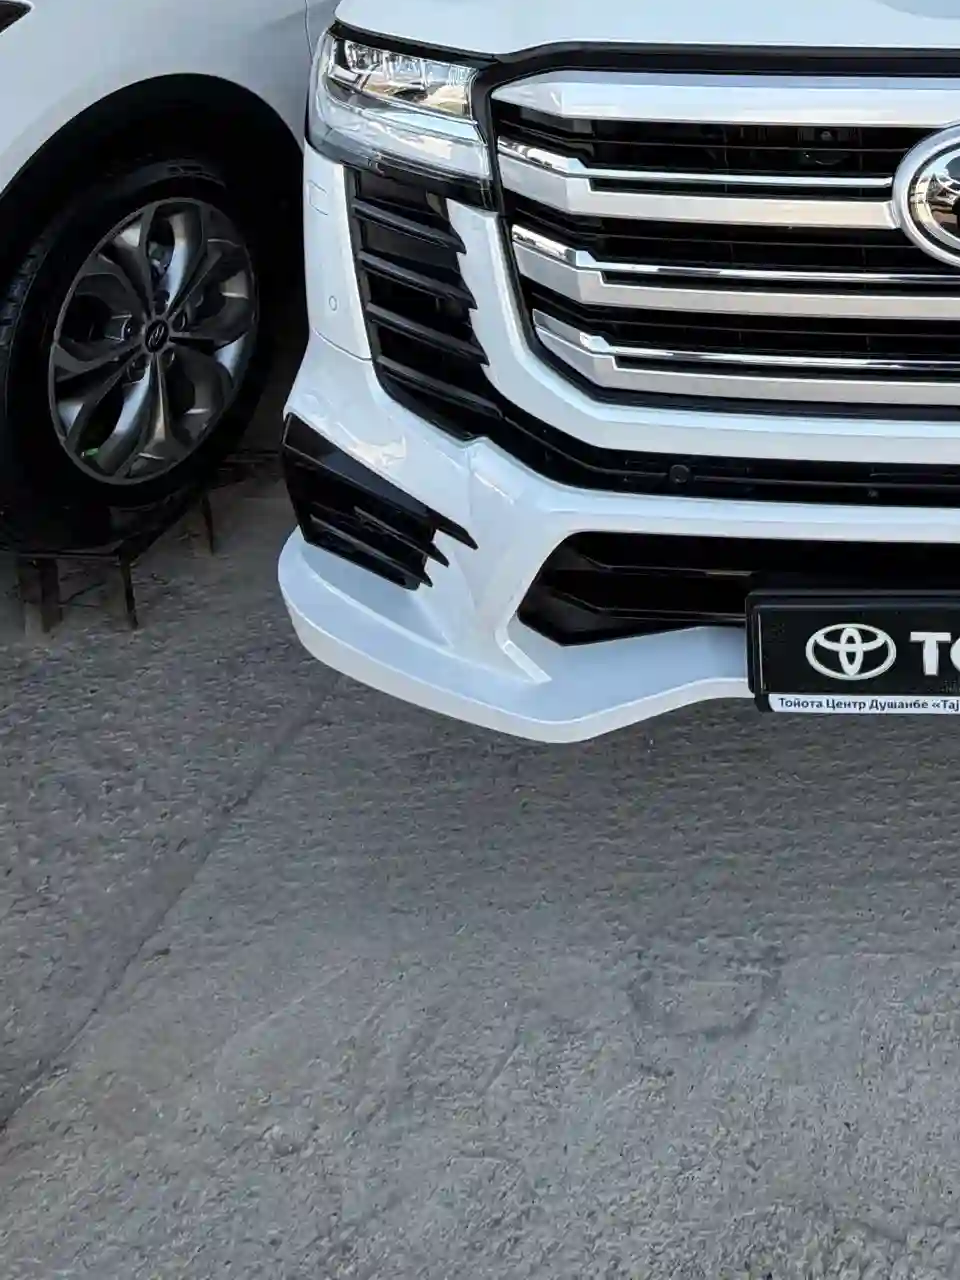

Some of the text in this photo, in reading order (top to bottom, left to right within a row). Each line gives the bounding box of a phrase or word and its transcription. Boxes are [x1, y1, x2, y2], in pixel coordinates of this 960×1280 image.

[778, 697, 823, 709] Тойота
[825, 698, 867, 711] Центр
[869, 698, 929, 711] Душанбе
